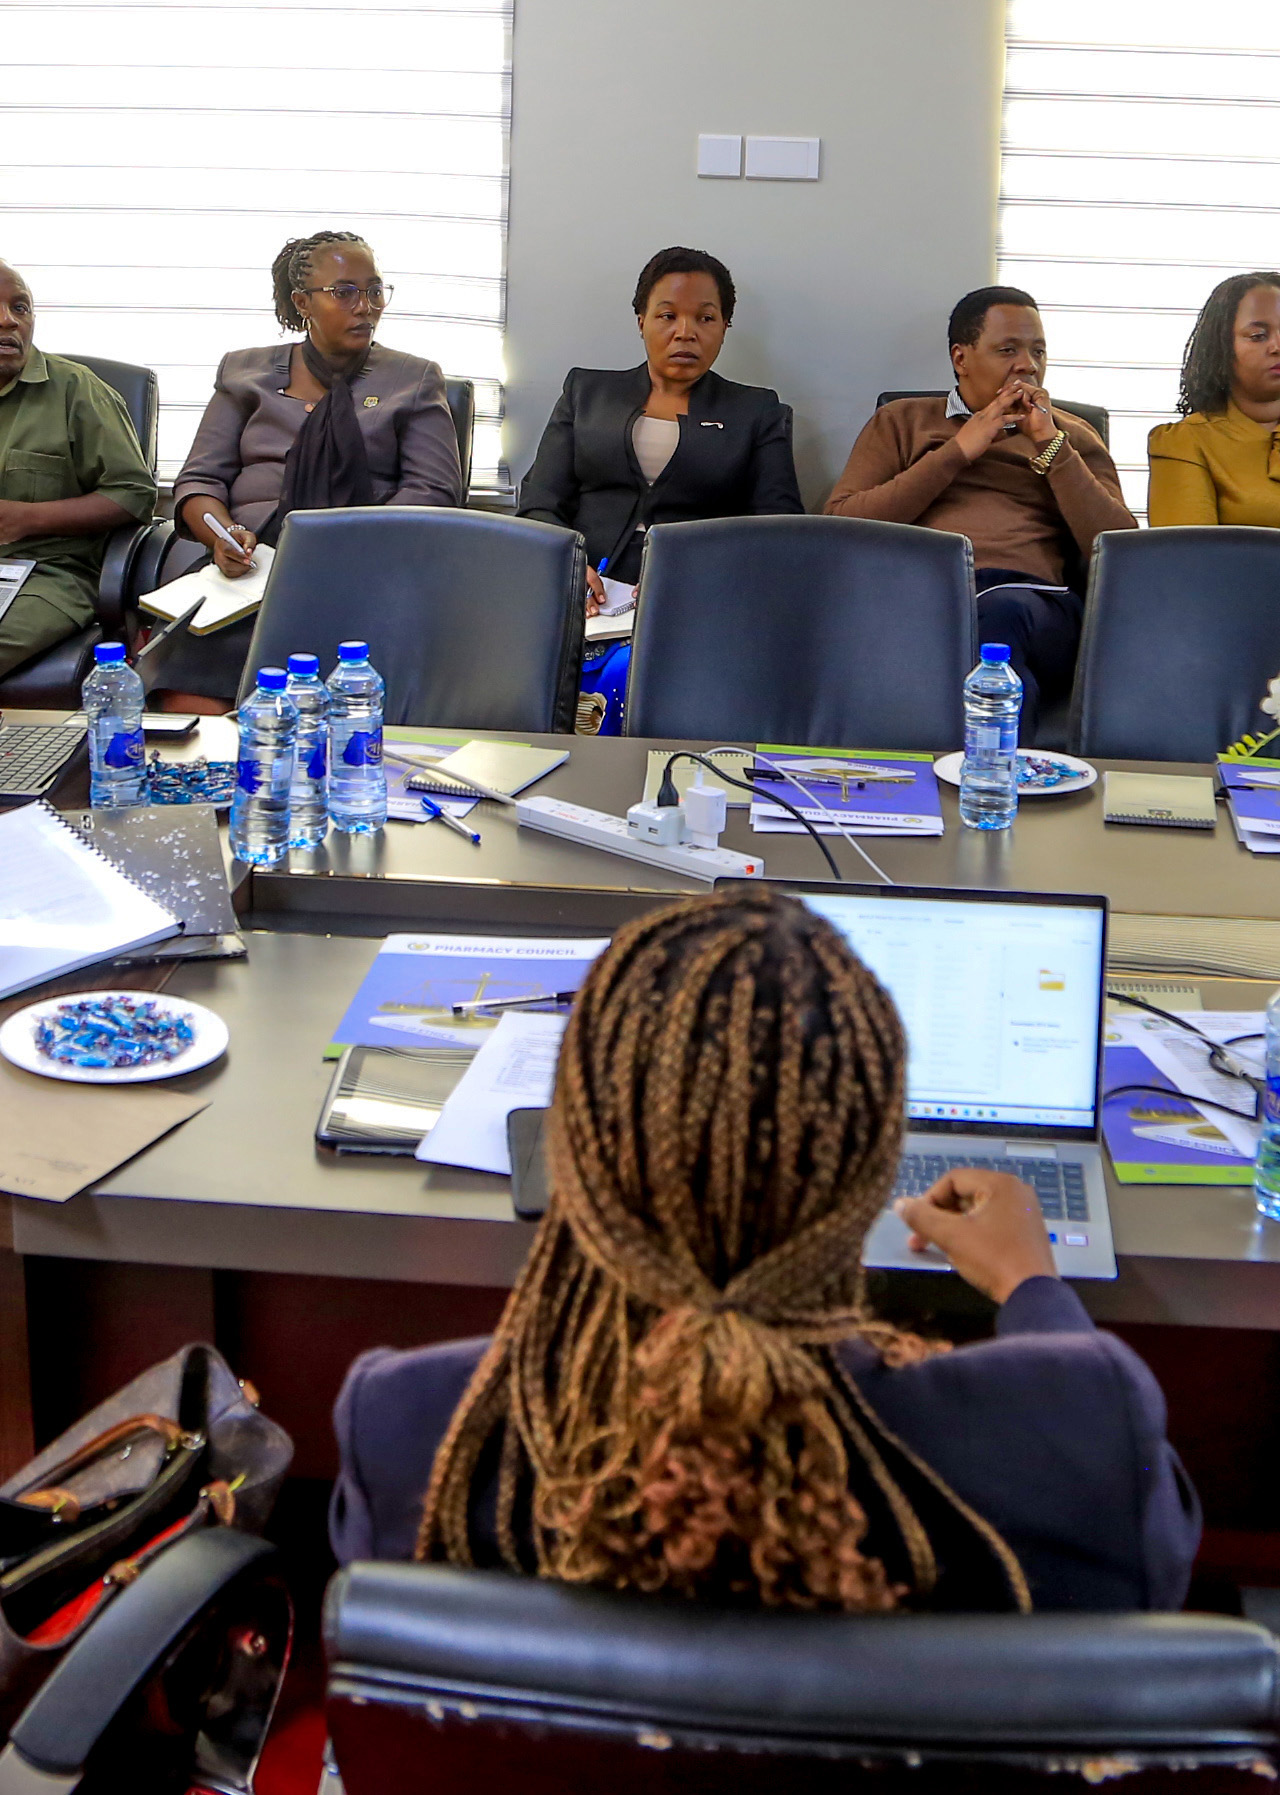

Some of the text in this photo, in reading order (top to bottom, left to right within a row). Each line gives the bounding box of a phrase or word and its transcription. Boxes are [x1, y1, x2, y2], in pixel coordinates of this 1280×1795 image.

[777, 807, 899, 822] PHARMACY COUNIL
[434, 944, 578, 956] PHARMACY COUNCIL
